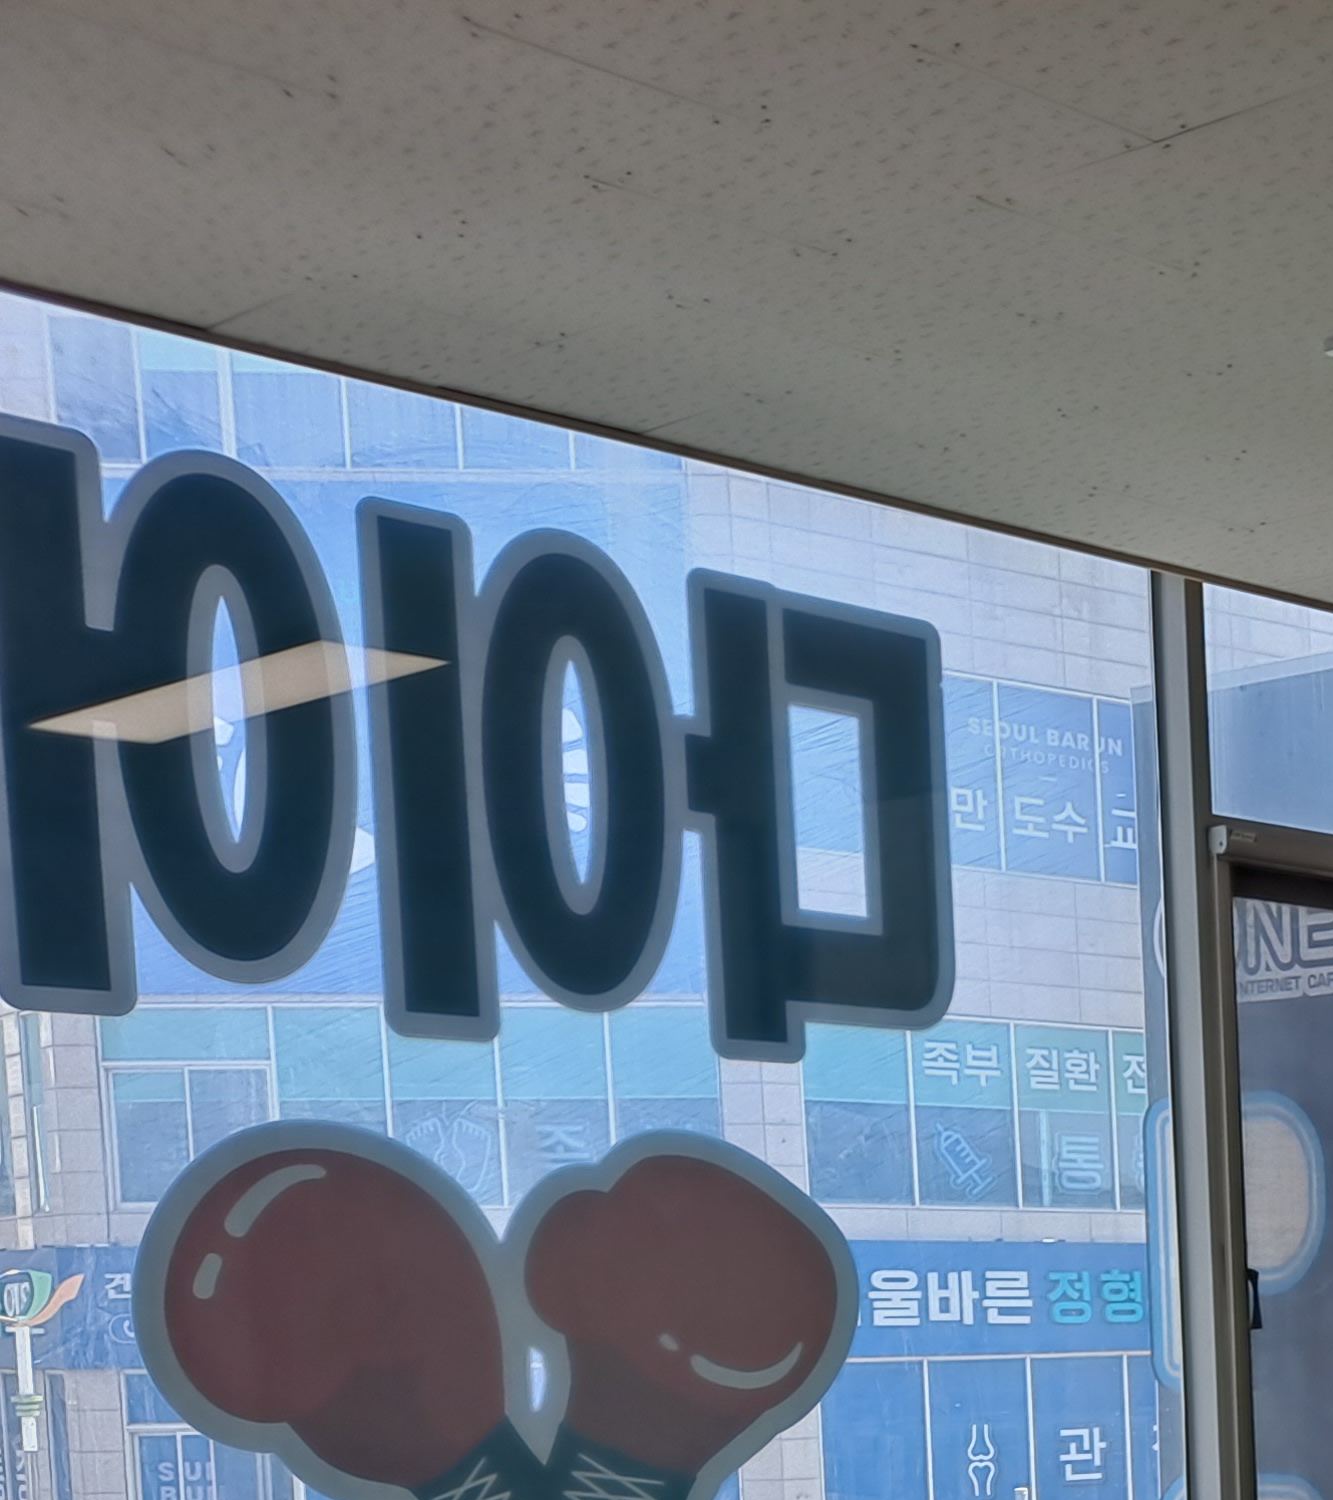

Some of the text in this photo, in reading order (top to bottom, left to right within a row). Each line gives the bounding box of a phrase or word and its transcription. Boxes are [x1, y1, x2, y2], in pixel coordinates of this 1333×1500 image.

[1012, 796, 1088, 843] 도수
[921, 1040, 1001, 1086] 족부
[1025, 1047, 1100, 1091] 질환
[857, 1269, 1033, 1327] 울바른
